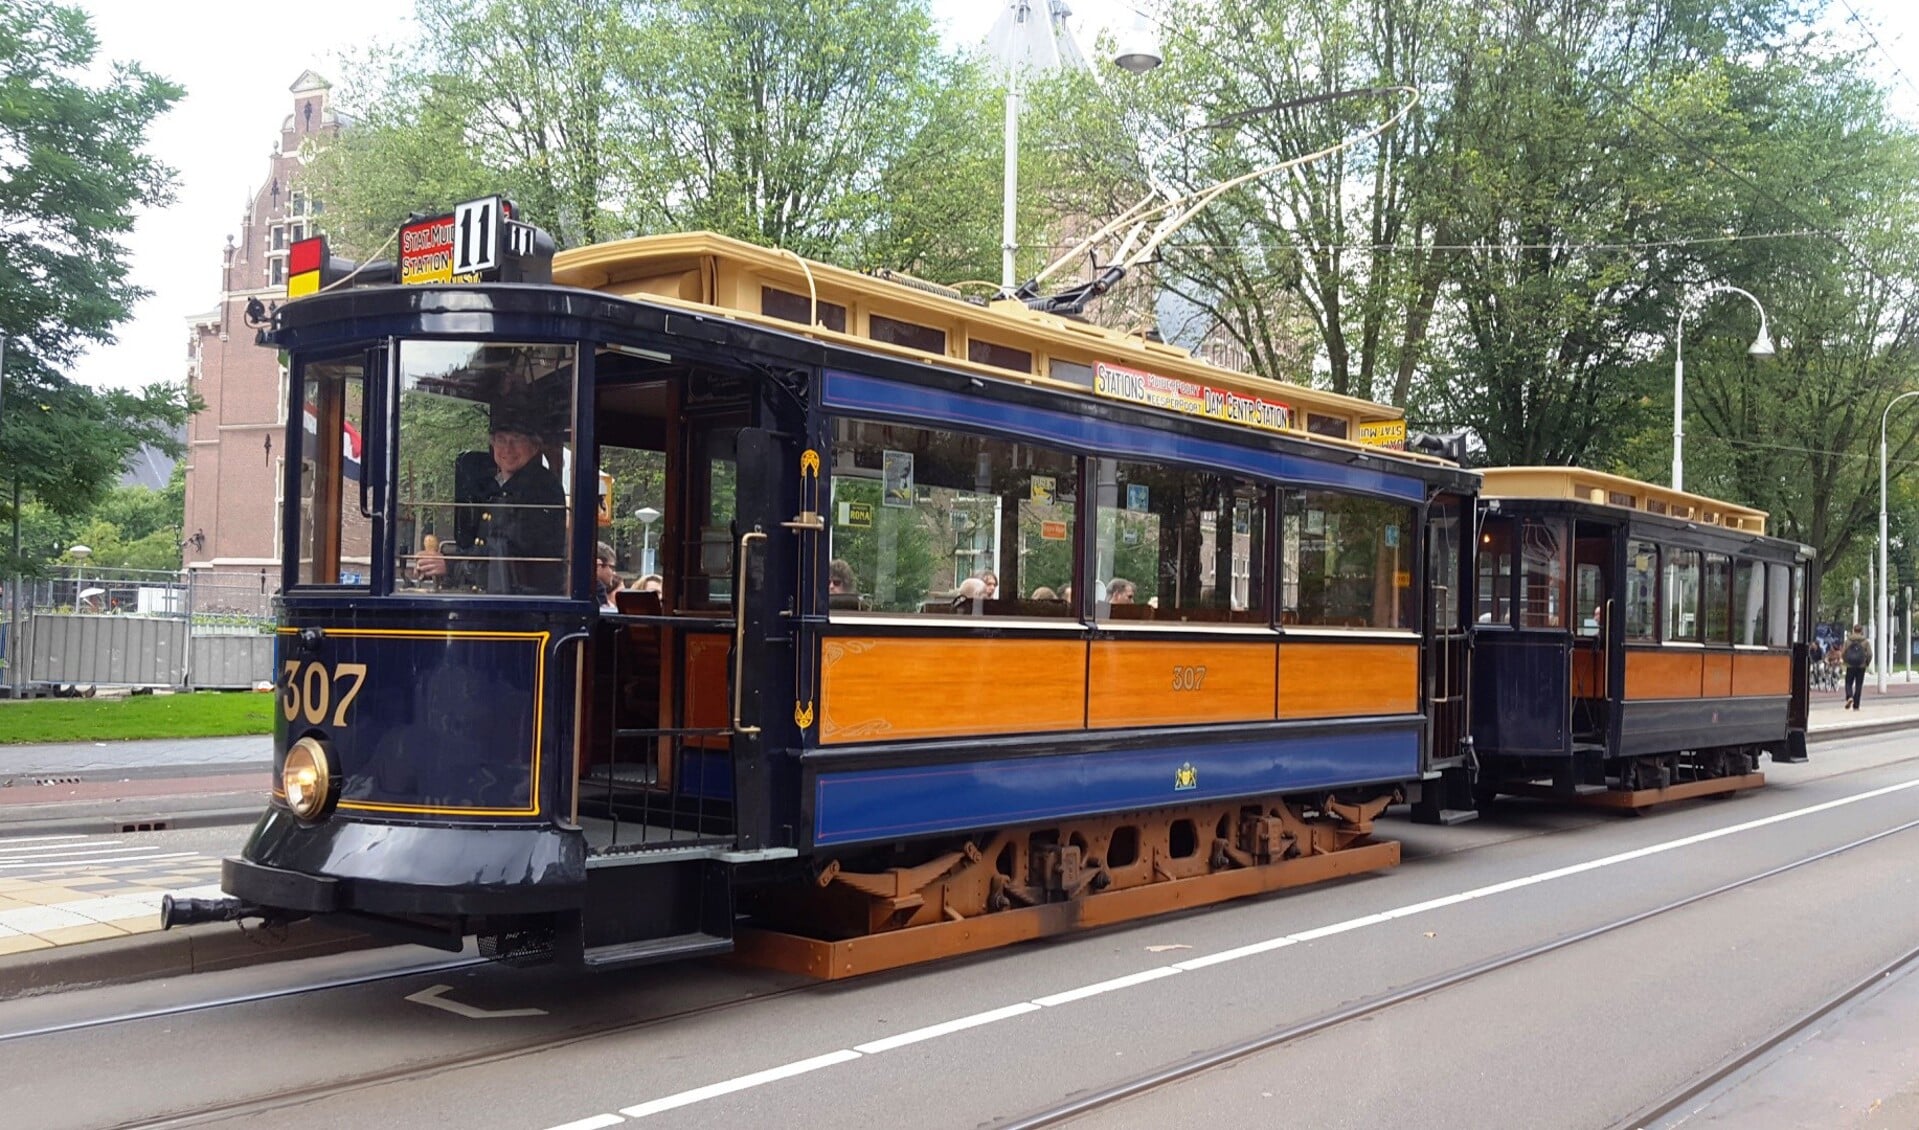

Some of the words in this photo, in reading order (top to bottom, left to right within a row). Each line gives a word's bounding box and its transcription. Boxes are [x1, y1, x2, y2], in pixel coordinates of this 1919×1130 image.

[458, 204, 490, 268] 11
[514, 226, 532, 253] 11
[402, 251, 450, 277] STATION
[1098, 364, 1145, 401] STATIONS
[1204, 388, 1224, 416] DAM
[1256, 399, 1288, 429] STATION
[283, 660, 367, 728] 307
[1172, 666, 1206, 692] 307
